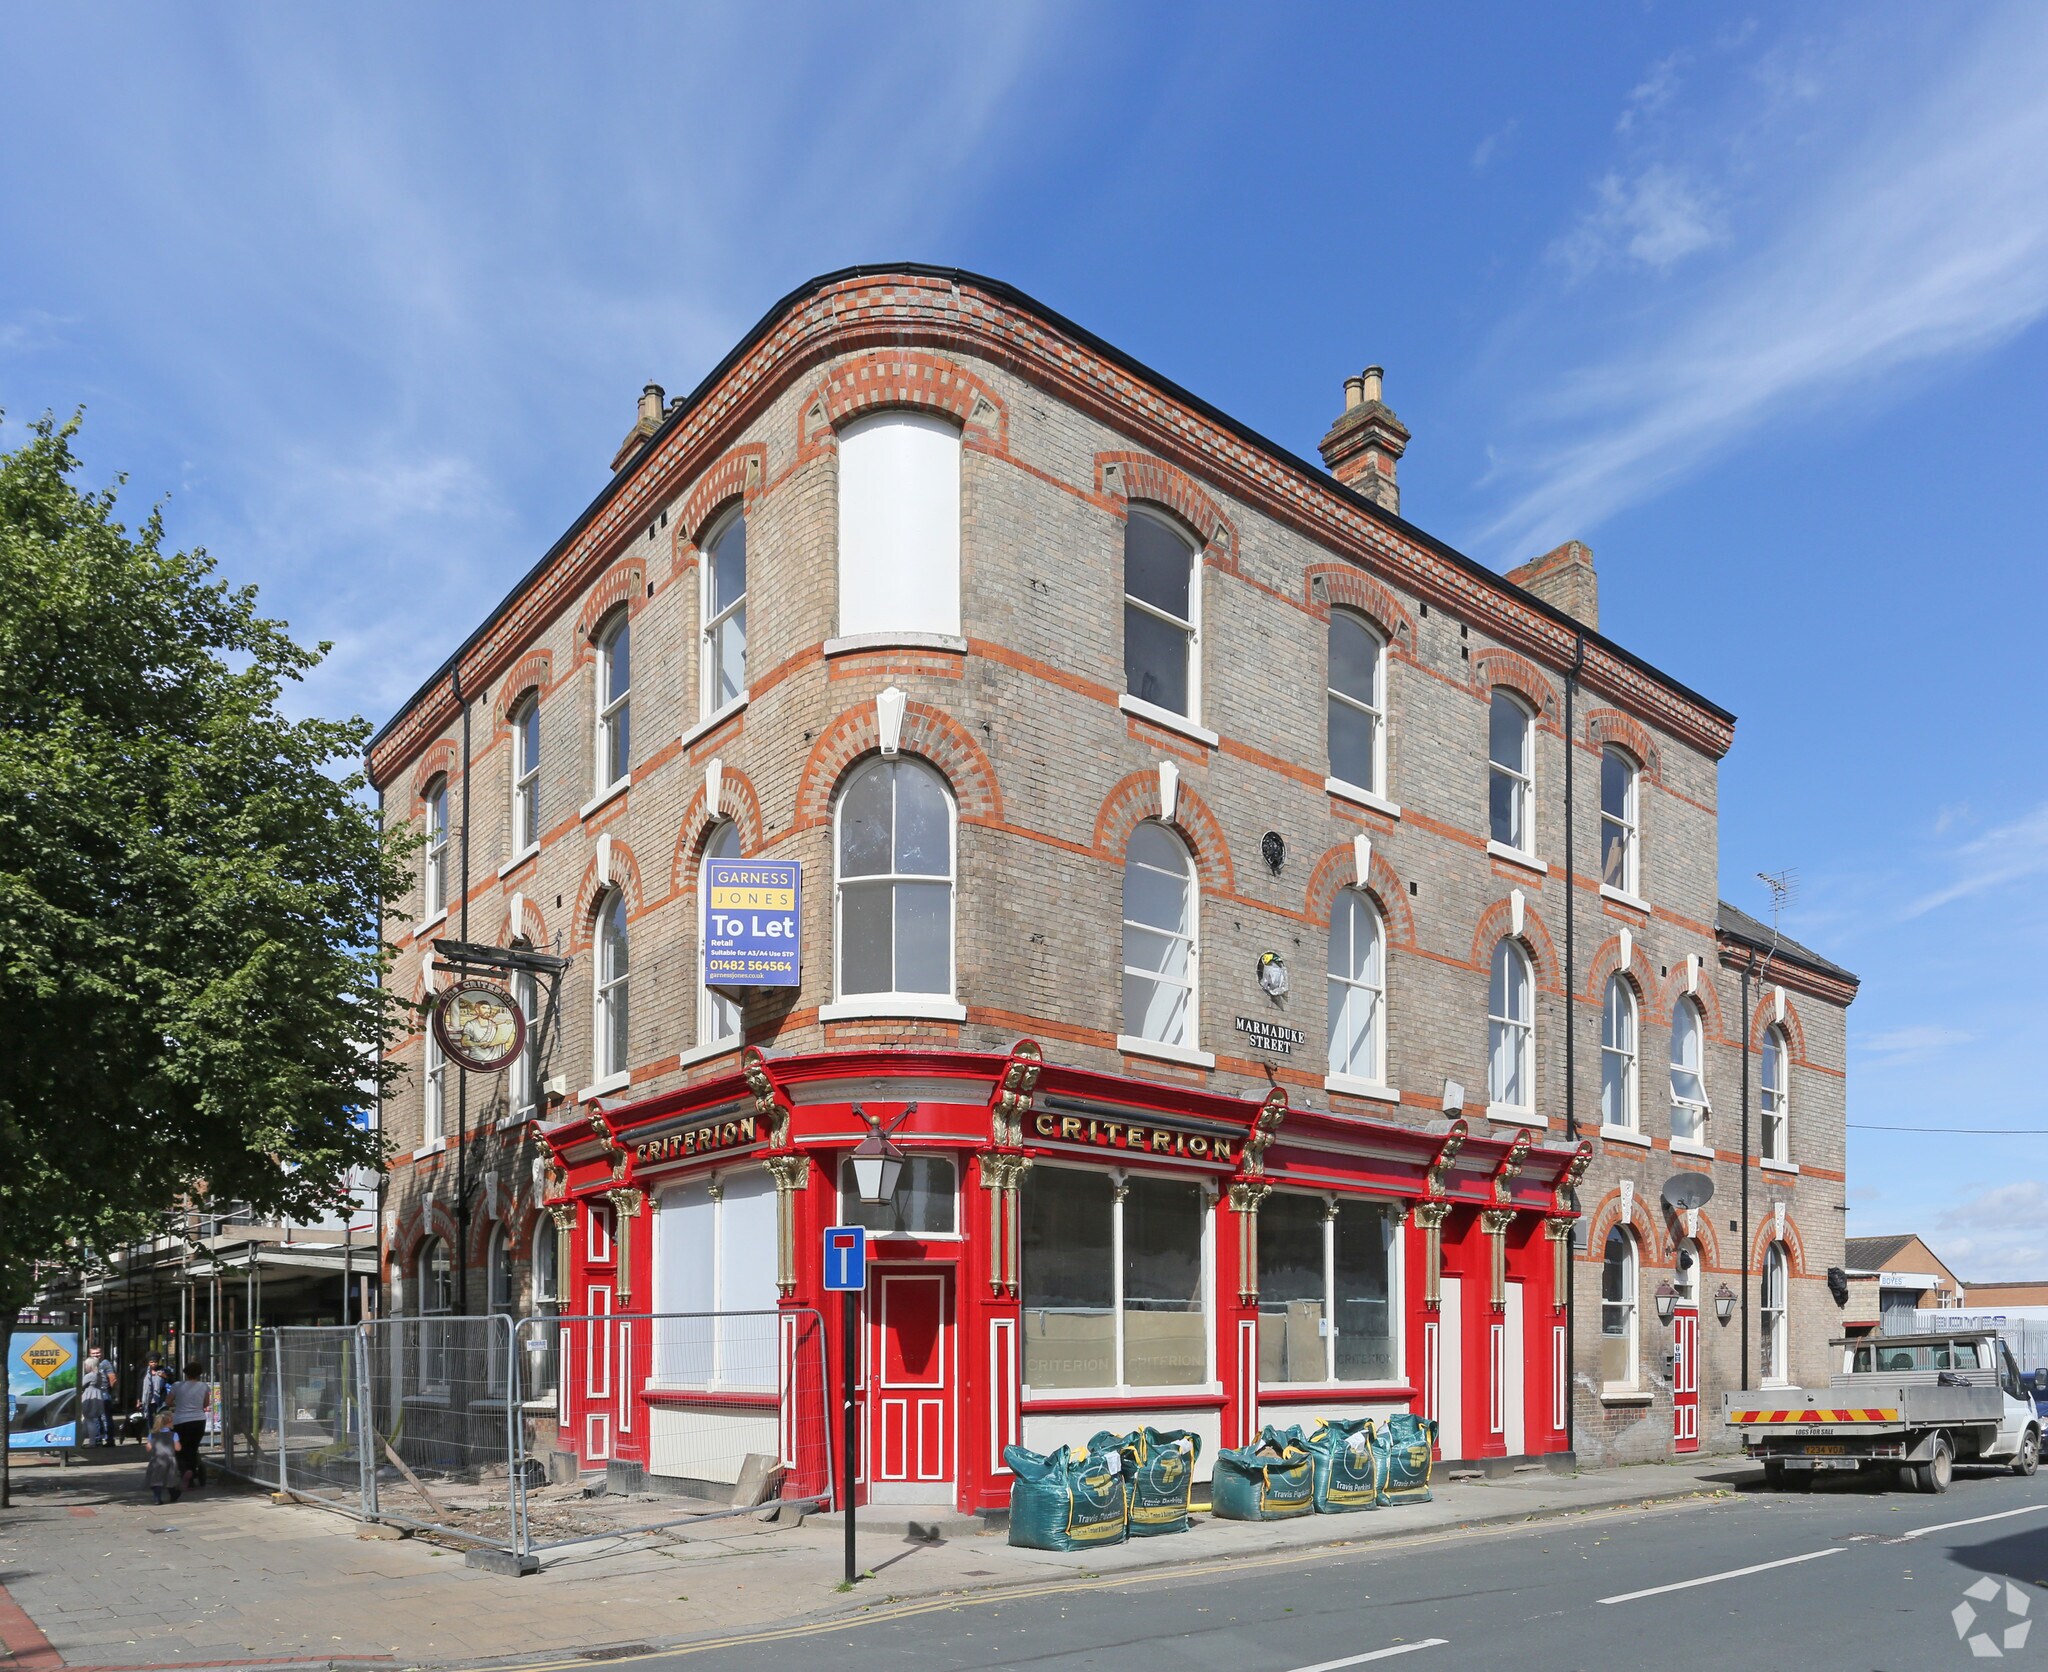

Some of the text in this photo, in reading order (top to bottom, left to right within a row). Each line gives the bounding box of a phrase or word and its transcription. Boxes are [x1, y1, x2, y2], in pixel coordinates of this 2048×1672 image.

[718, 871, 788, 885] GARNESS
[718, 892, 788, 905] JONES
[712, 915, 795, 938] To Let
[711, 939, 734, 947] Retail
[710, 960, 792, 972] 01482 564564
[462, 980, 518, 1008] CRITERION
[1236, 1017, 1305, 1044] MARMADUKE
[1249, 1034, 1291, 1053] STREET
[636, 1117, 757, 1163] CRITERION
[1035, 1114, 1232, 1160] CRITERION
[1881, 1277, 1903, 1285] BOYES
[29, 1349, 61, 1357] ARRIVE
[32, 1358, 57, 1366] FRESH
[1027, 1358, 1109, 1372] CRITERION
[1336, 1480, 1371, 1491] Travis Perkins
[1393, 1479, 1409, 1487] Travis
[1273, 1490, 1293, 1498] Travis
[1078, 1514, 1098, 1523] Travis
